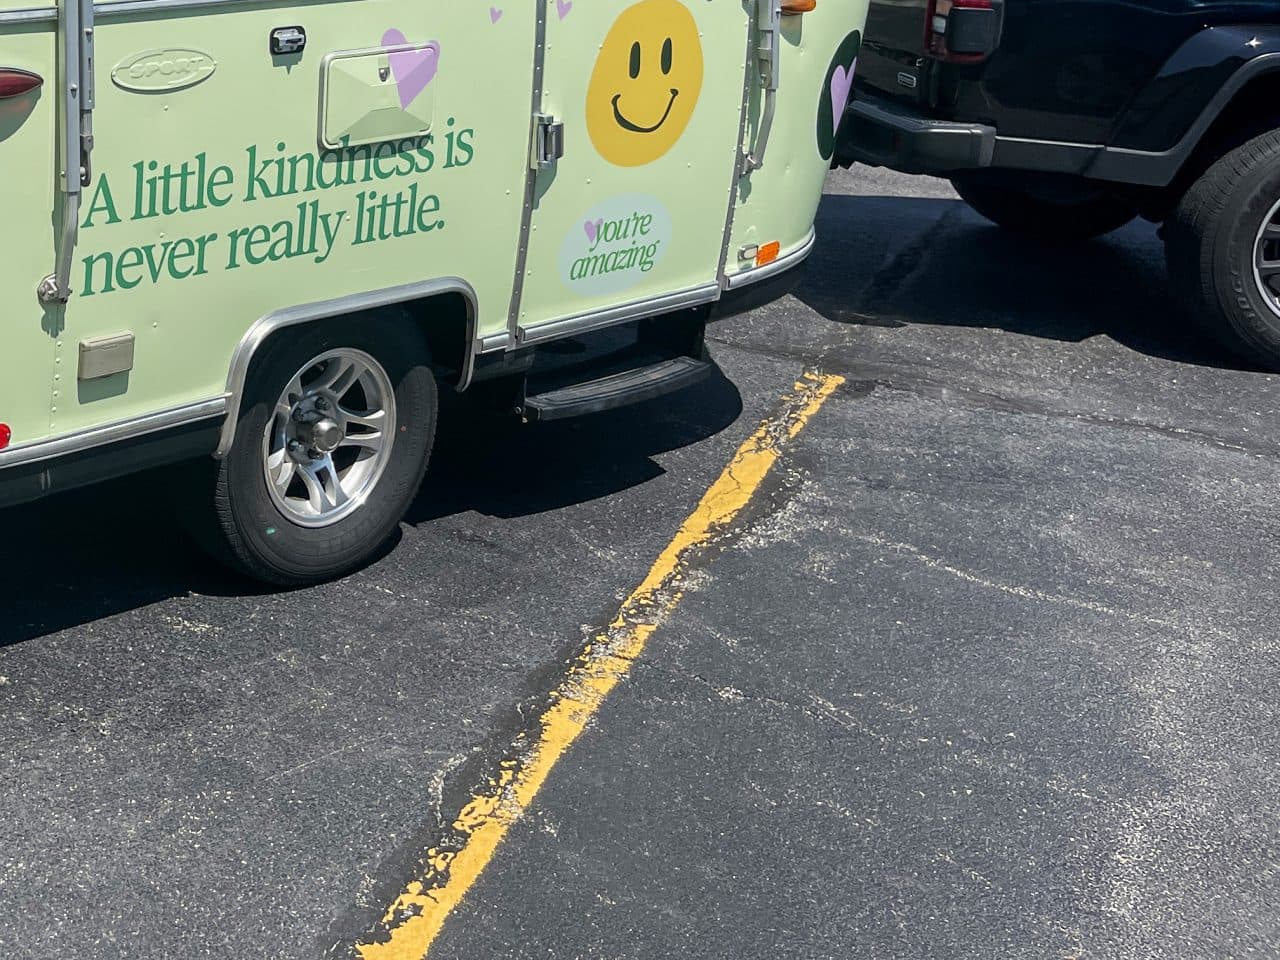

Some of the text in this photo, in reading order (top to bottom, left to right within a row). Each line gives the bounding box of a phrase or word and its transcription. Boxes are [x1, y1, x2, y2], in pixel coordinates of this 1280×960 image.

[129, 57, 204, 79] SPORT
[80, 117, 474, 228] A little kindness is
[80, 183, 445, 297] never really little.
[589, 211, 652, 252] you're
[570, 240, 660, 281] amazing
